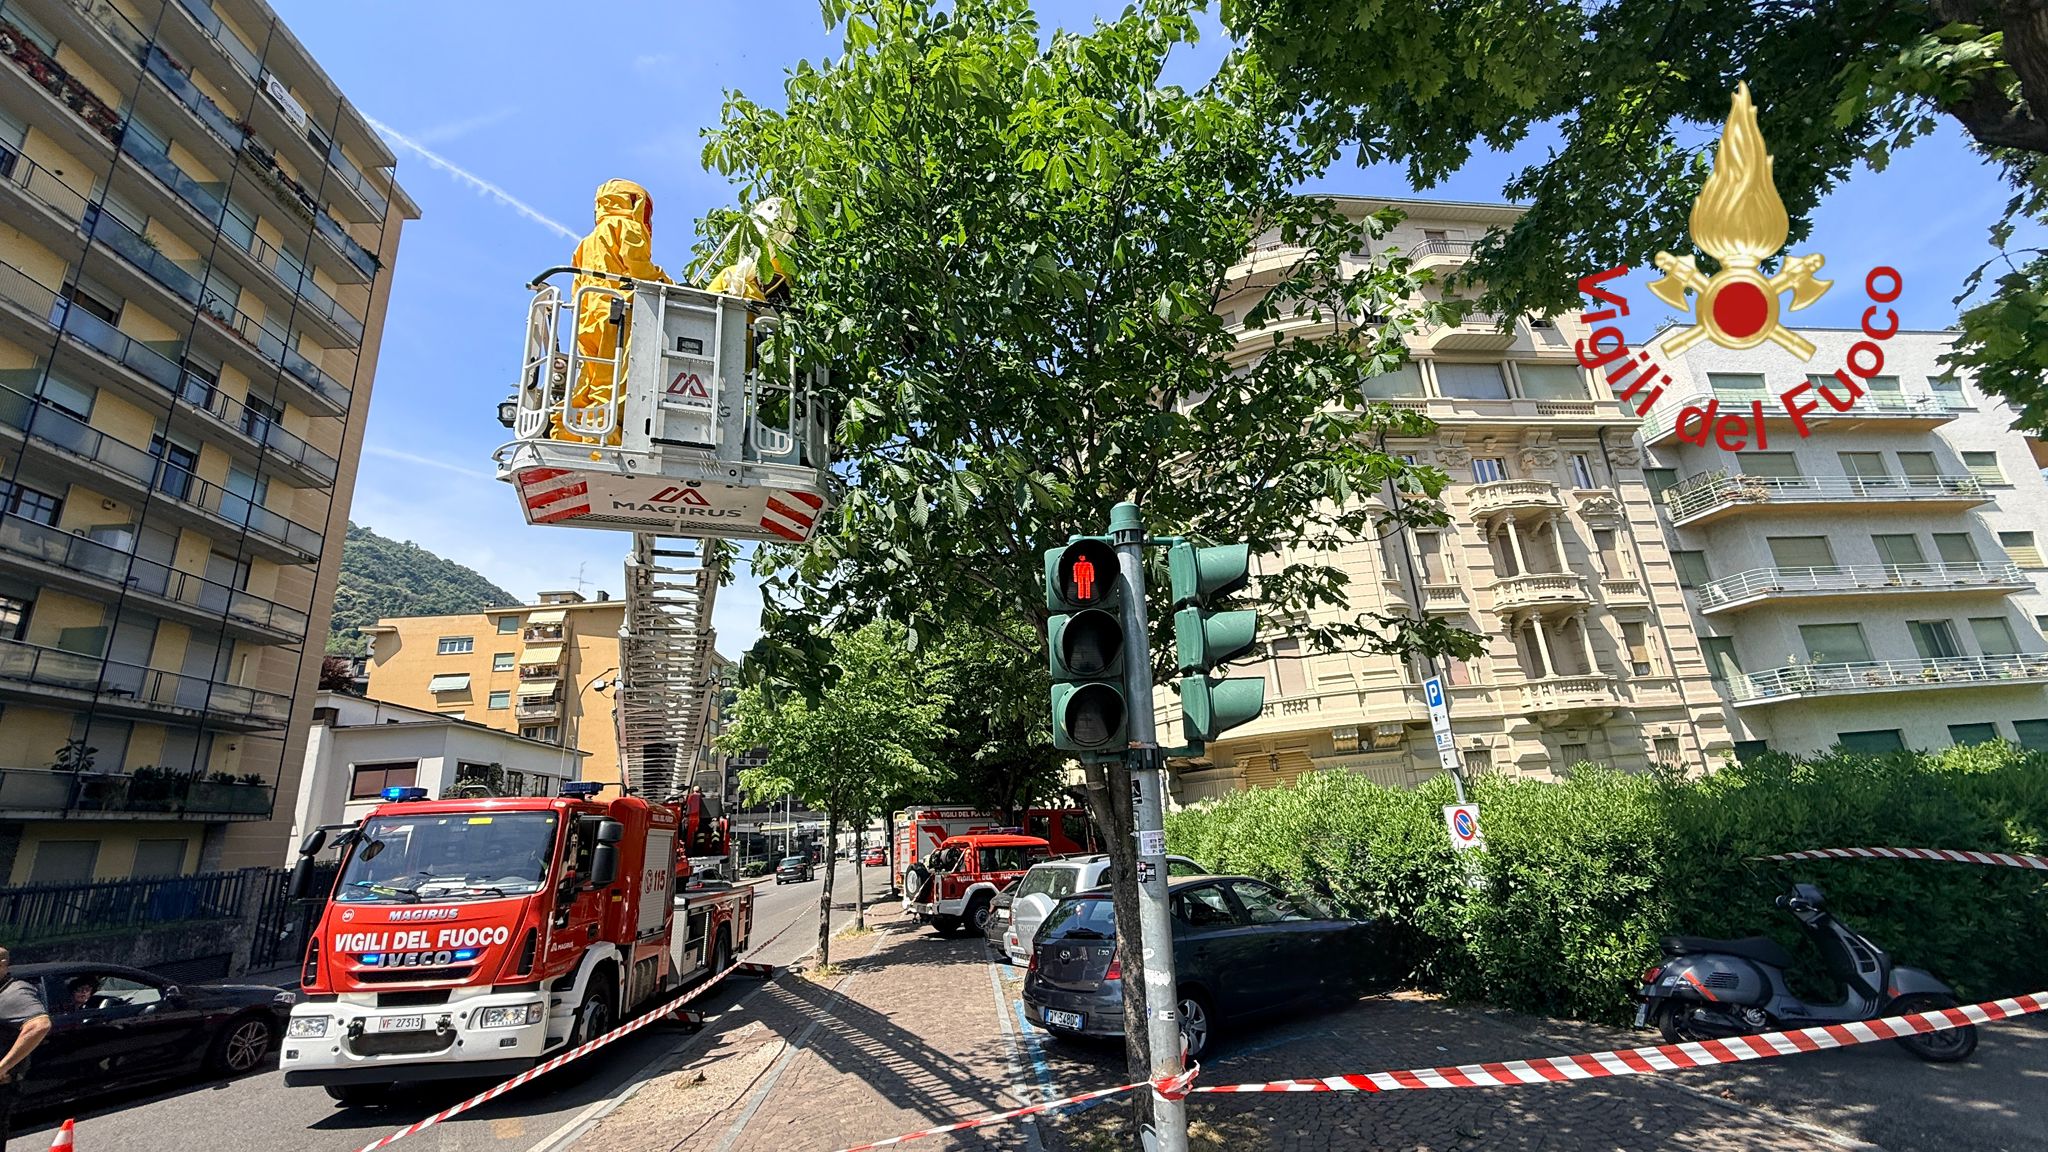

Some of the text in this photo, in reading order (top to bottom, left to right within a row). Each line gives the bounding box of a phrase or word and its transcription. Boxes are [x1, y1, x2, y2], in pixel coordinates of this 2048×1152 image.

[612, 501, 742, 518] MAGIRUS
[1428, 684, 1438, 704] P
[940, 810, 957, 818] VIGILI
[958, 810, 970, 818] DEL
[653, 870, 666, 891] 115
[388, 908, 459, 922] MAGIRUS
[335, 926, 509, 952] VIGILI DEL FUOCO
[377, 950, 452, 968] IVECO
[382, 1017, 421, 1029] VF 27313
